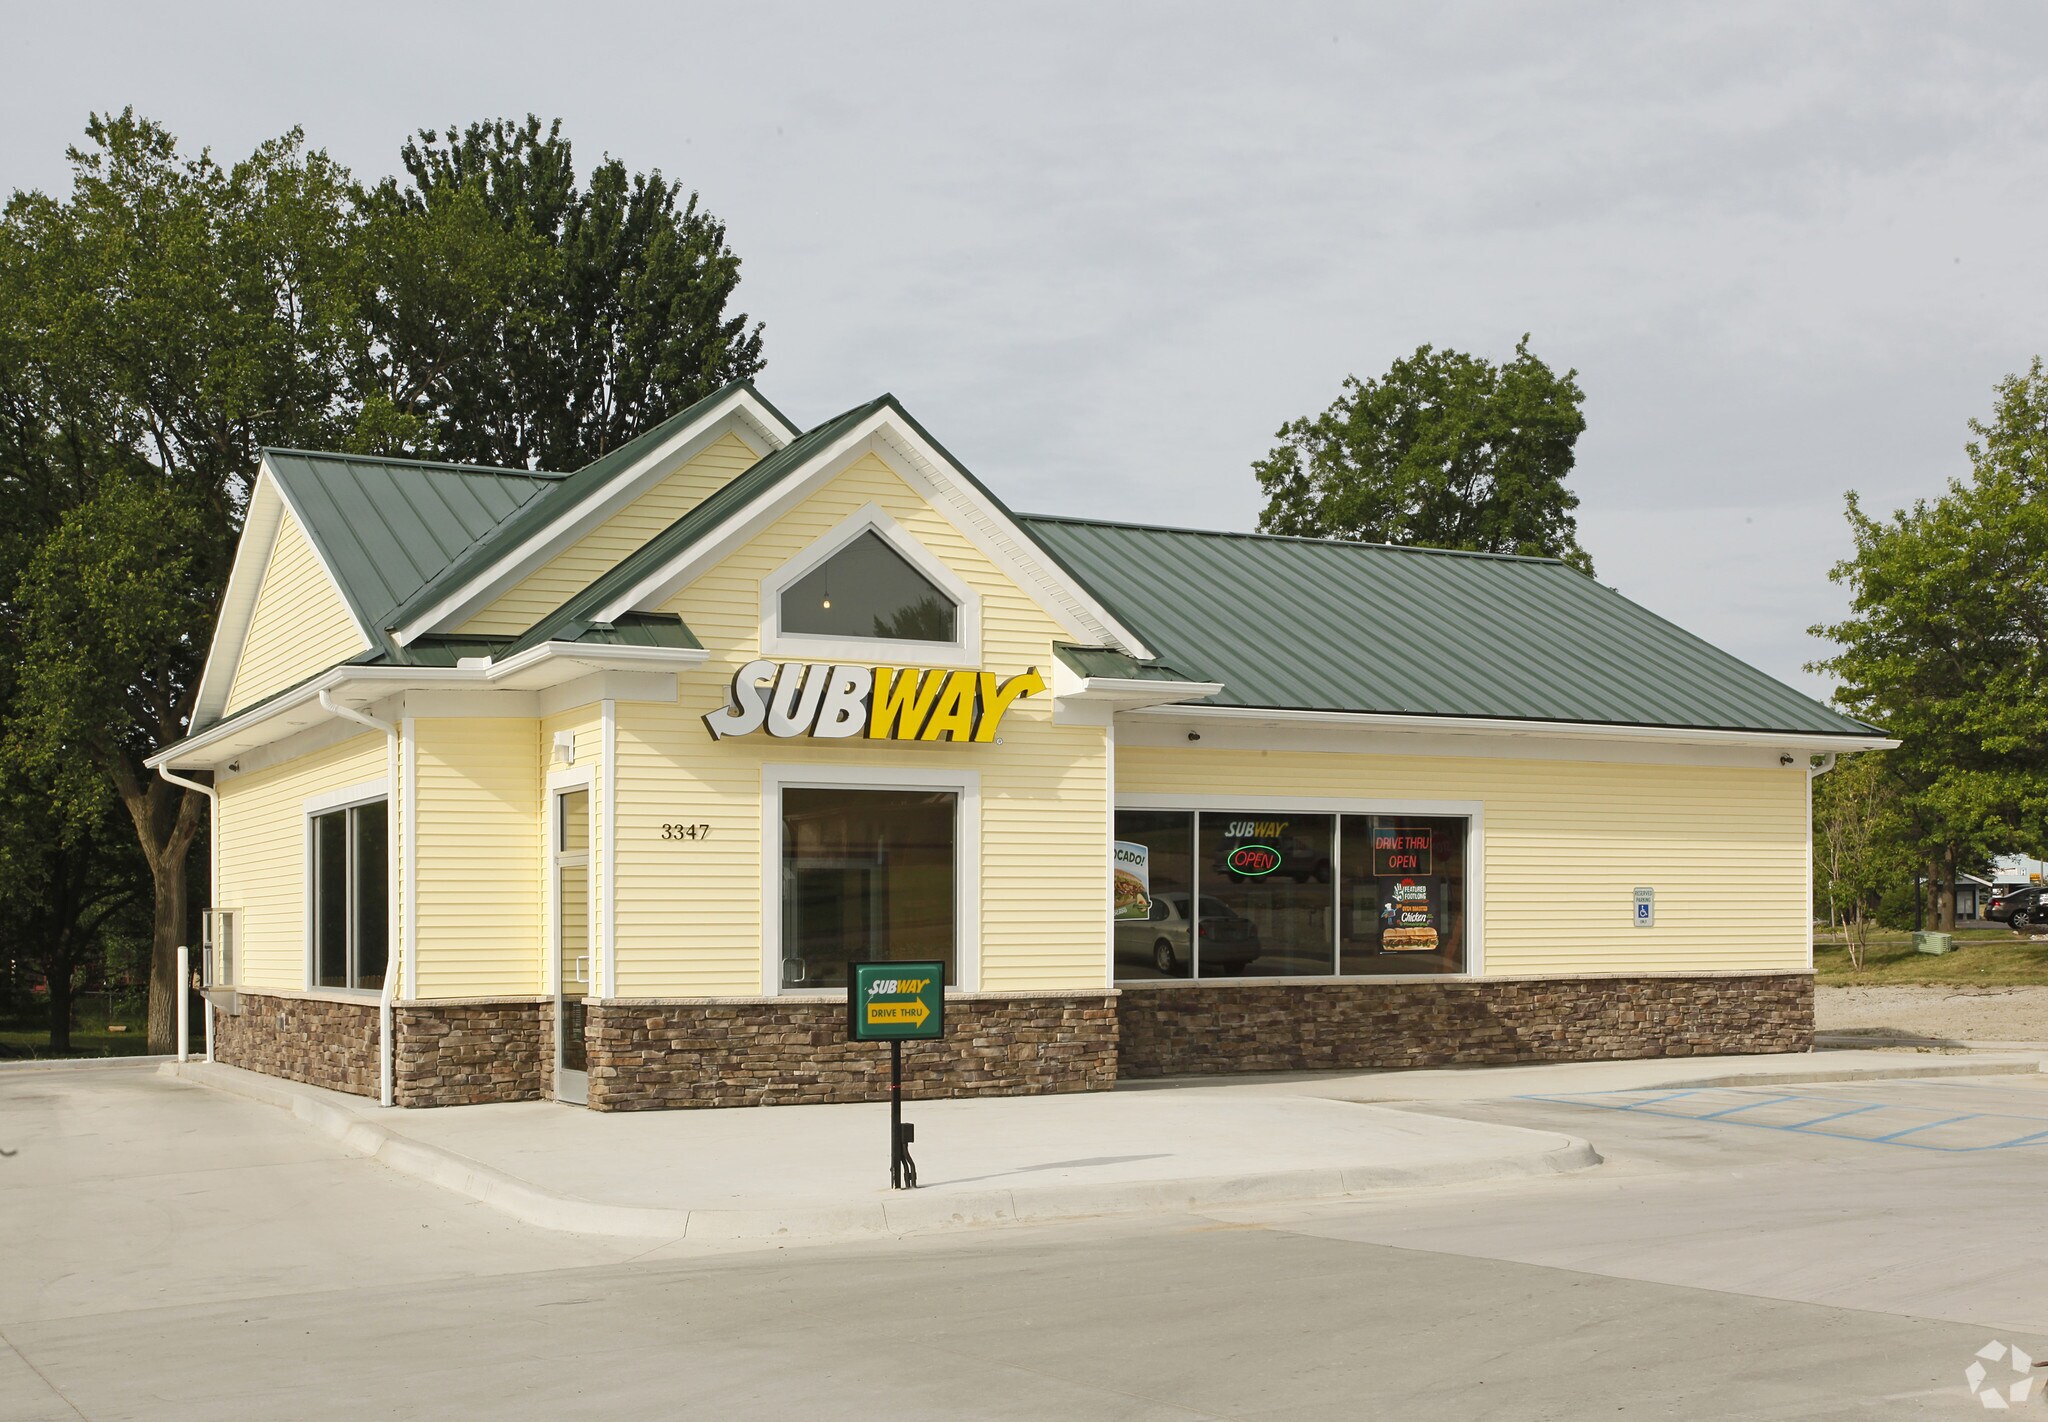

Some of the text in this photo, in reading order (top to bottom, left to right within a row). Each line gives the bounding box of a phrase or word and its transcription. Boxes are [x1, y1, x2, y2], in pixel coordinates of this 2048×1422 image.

[701, 659, 1046, 743] SUBWAY
[661, 823, 709, 840] 3347
[1224, 821, 1289, 837] SUBWAY
[1376, 837, 1403, 849] DRIVE
[1405, 837, 1429, 849] THRU
[1235, 850, 1274, 869] OPEN
[1389, 856, 1416, 868] OPEN
[1401, 912, 1427, 922] Chicken
[868, 978, 931, 995] SUBWAY
[871, 1008, 923, 1018] DRIVE THRU
